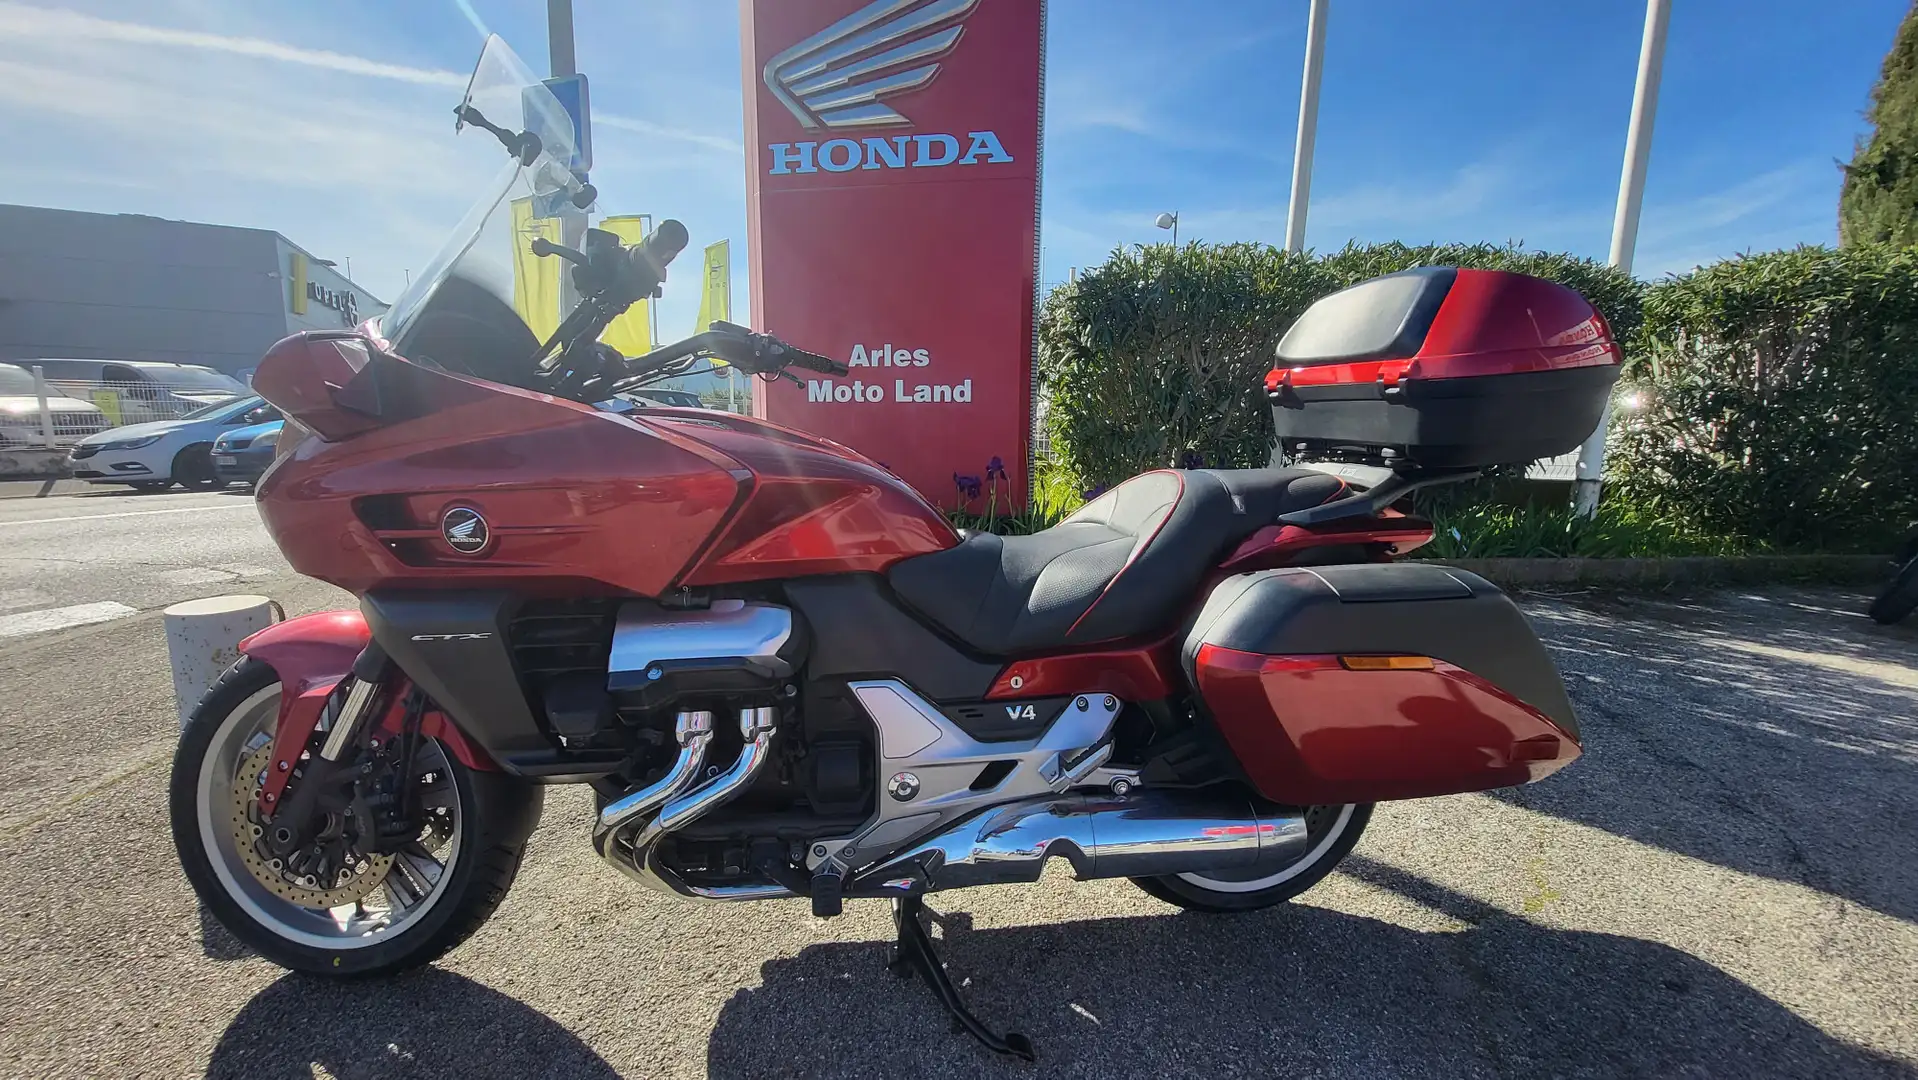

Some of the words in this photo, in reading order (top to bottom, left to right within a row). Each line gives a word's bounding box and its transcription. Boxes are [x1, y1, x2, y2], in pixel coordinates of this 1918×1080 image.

[768, 131, 1014, 175] HONDA
[314, 283, 345, 312] OPEL
[848, 344, 930, 367] Arles
[808, 380, 884, 403] Moto
[895, 379, 972, 403] Land
[411, 631, 493, 641] CTX
[1005, 704, 1037, 720] V4
